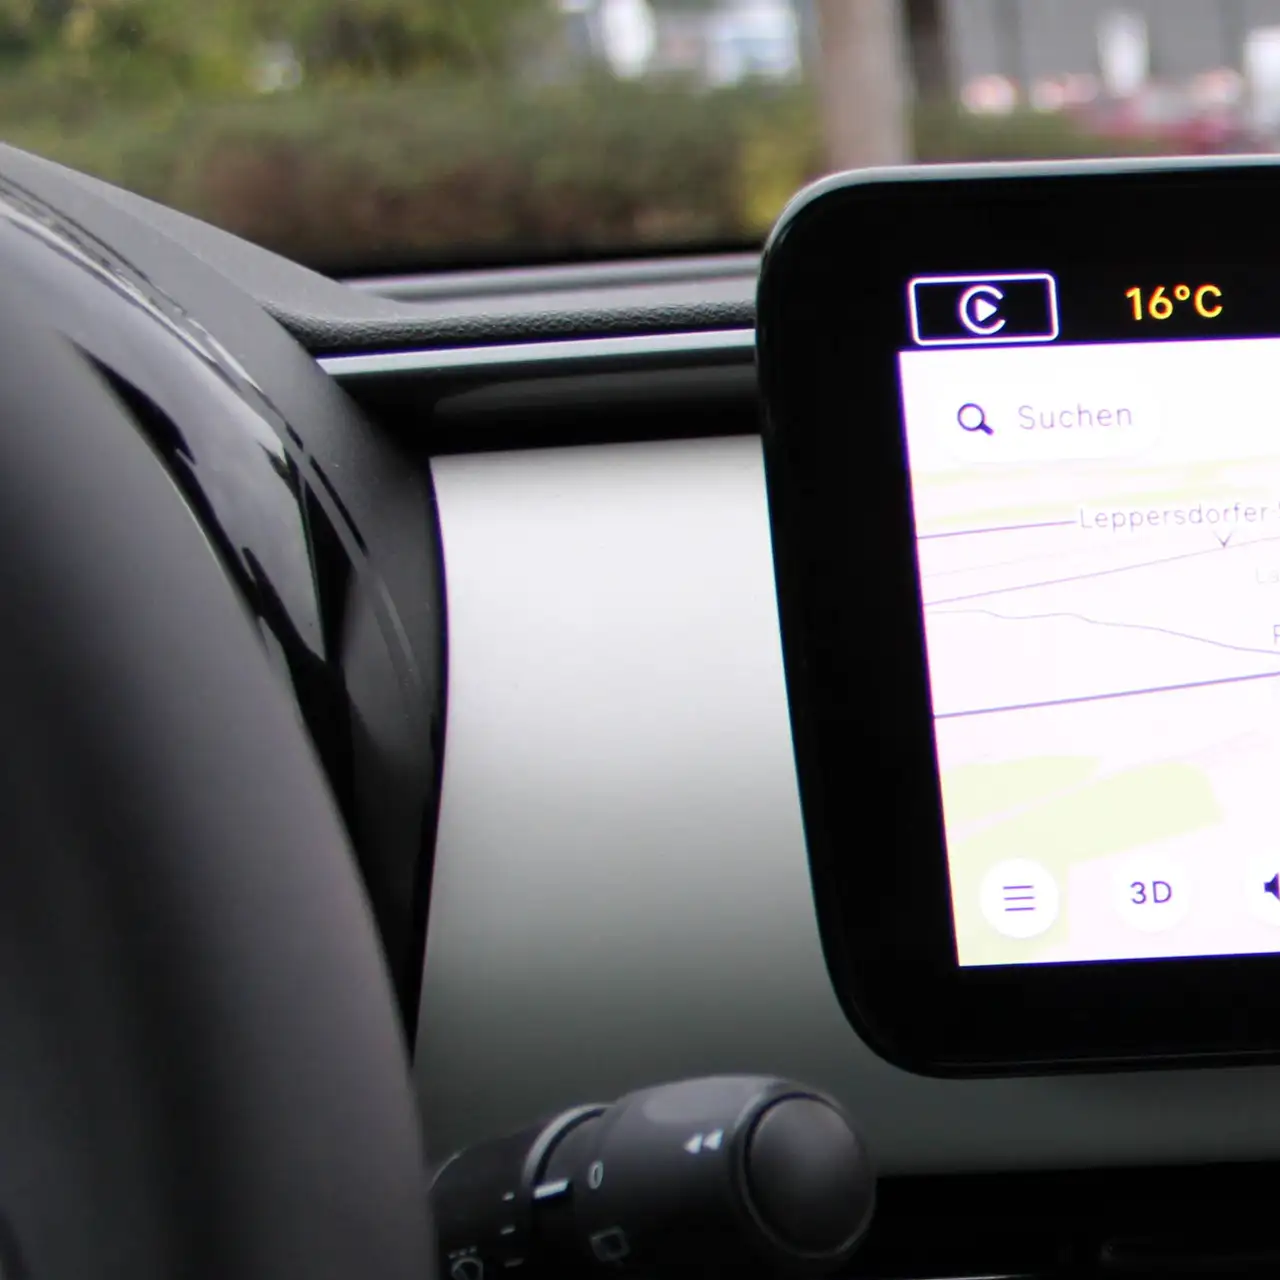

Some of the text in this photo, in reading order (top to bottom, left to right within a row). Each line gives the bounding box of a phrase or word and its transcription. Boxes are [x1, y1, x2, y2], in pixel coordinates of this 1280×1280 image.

[1017, 404, 1132, 431] Suchen
[1079, 502, 1269, 533] Leppersdorfer
[1130, 880, 1173, 905] 3D
